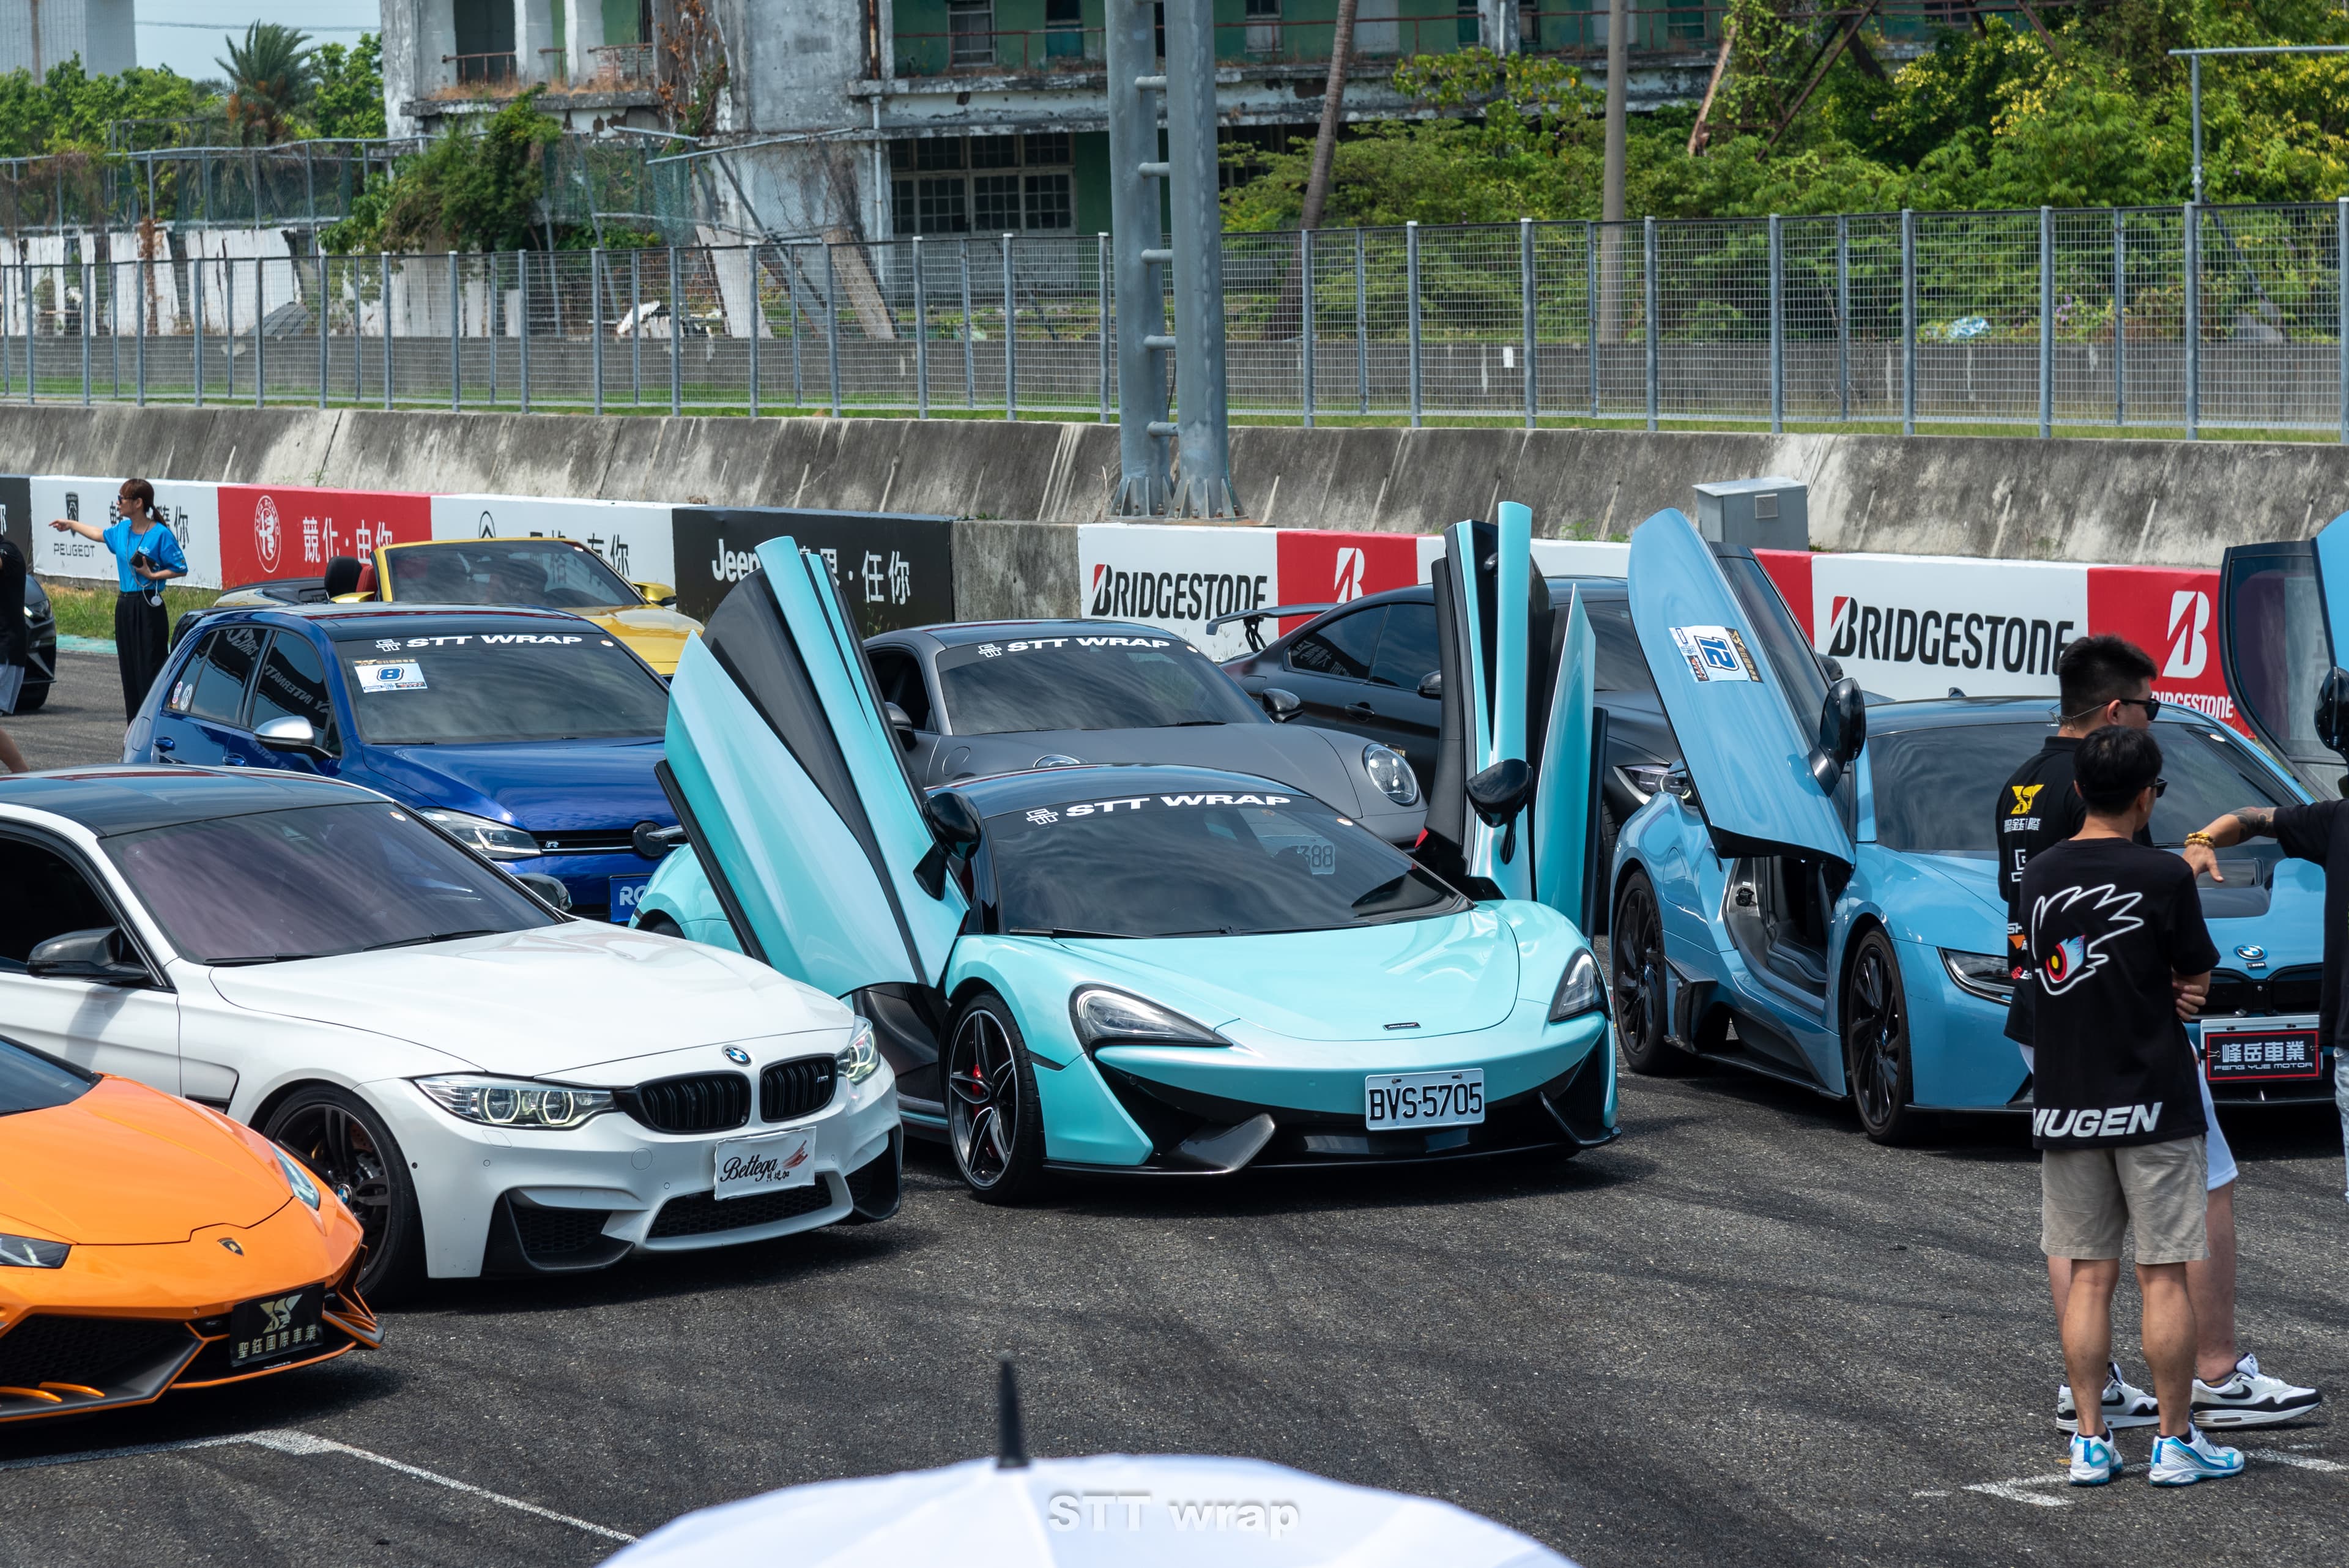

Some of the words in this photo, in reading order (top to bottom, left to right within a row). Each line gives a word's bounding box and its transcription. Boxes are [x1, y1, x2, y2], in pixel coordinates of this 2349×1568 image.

[54, 543, 95, 557] PEUGEOT
[1091, 564, 1267, 621] BRIDGESTONE
[407, 636, 472, 647] STT
[480, 634, 582, 644] WRAP
[1008, 638, 1068, 652] STT
[1076, 637, 1170, 648] WRAP
[1828, 596, 2074, 675] BRIDGESTONE
[1694, 635, 1740, 671] 12
[377, 666, 404, 682] 8
[1066, 797, 1150, 817] STT
[1160, 795, 1291, 806] WRAP
[2222, 1040, 2305, 1063] 峰岳車業
[2033, 1102, 2163, 1137] MUGEN
[720, 1154, 778, 1182] Bettega
[238, 1324, 317, 1359] 聖鈺國際車業
